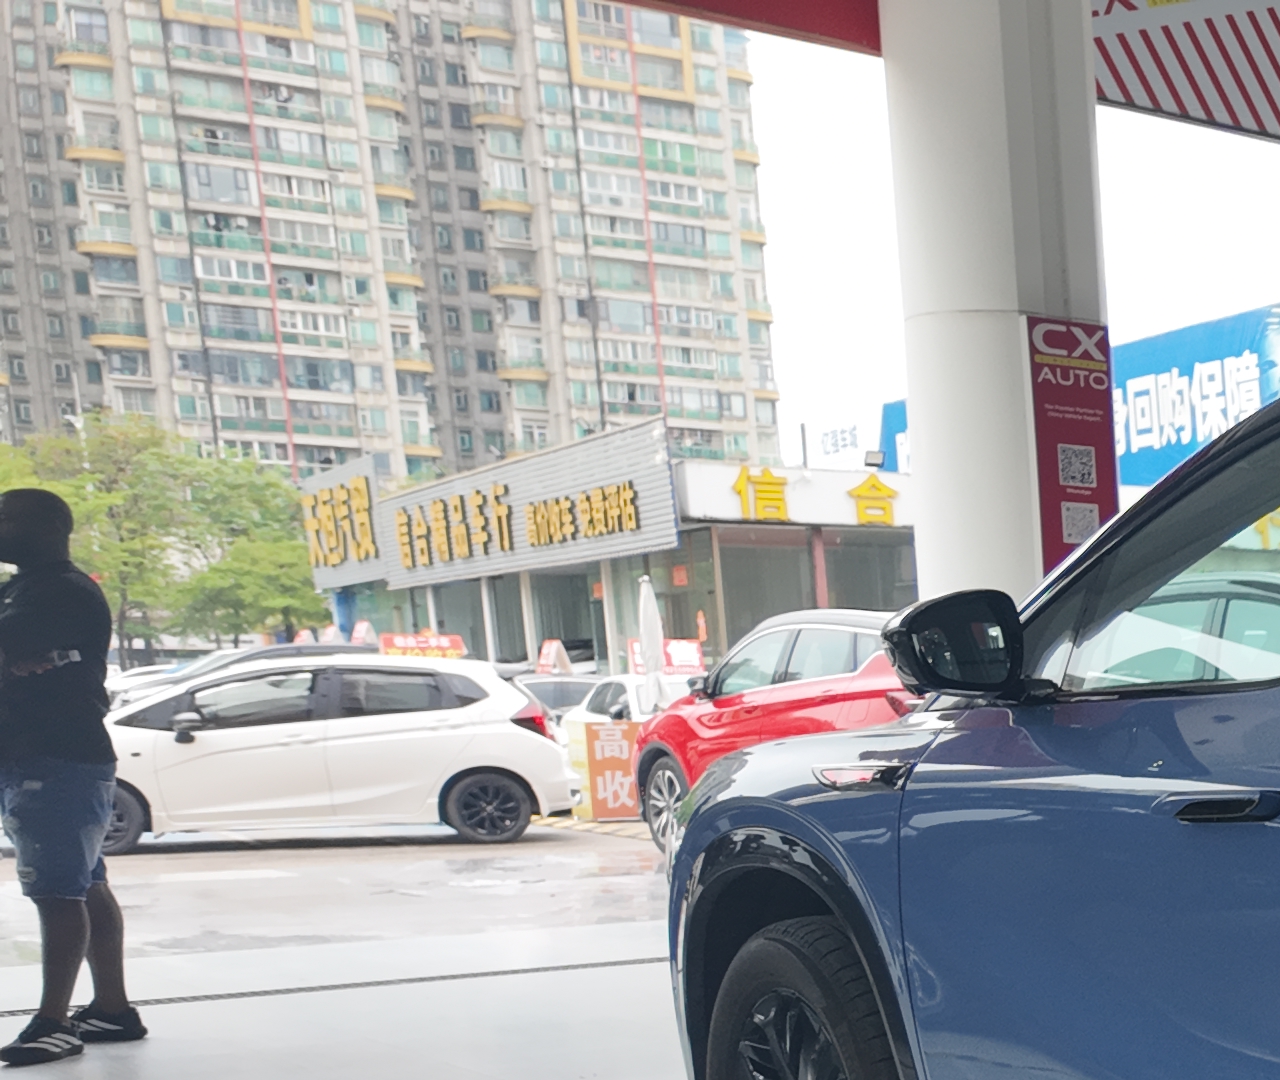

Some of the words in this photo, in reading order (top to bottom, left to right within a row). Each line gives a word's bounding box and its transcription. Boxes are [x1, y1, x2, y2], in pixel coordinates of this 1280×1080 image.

[1032, 322, 1107, 362] CX
[1037, 365, 1109, 391] AUTO
[525, 495, 575, 548] 高价收车
[577, 480, 639, 539] 免费评估
[732, 465, 898, 526] 信合
[395, 483, 513, 570] 信合精品车行
[591, 722, 629, 761] 高
[596, 769, 636, 809] 收
